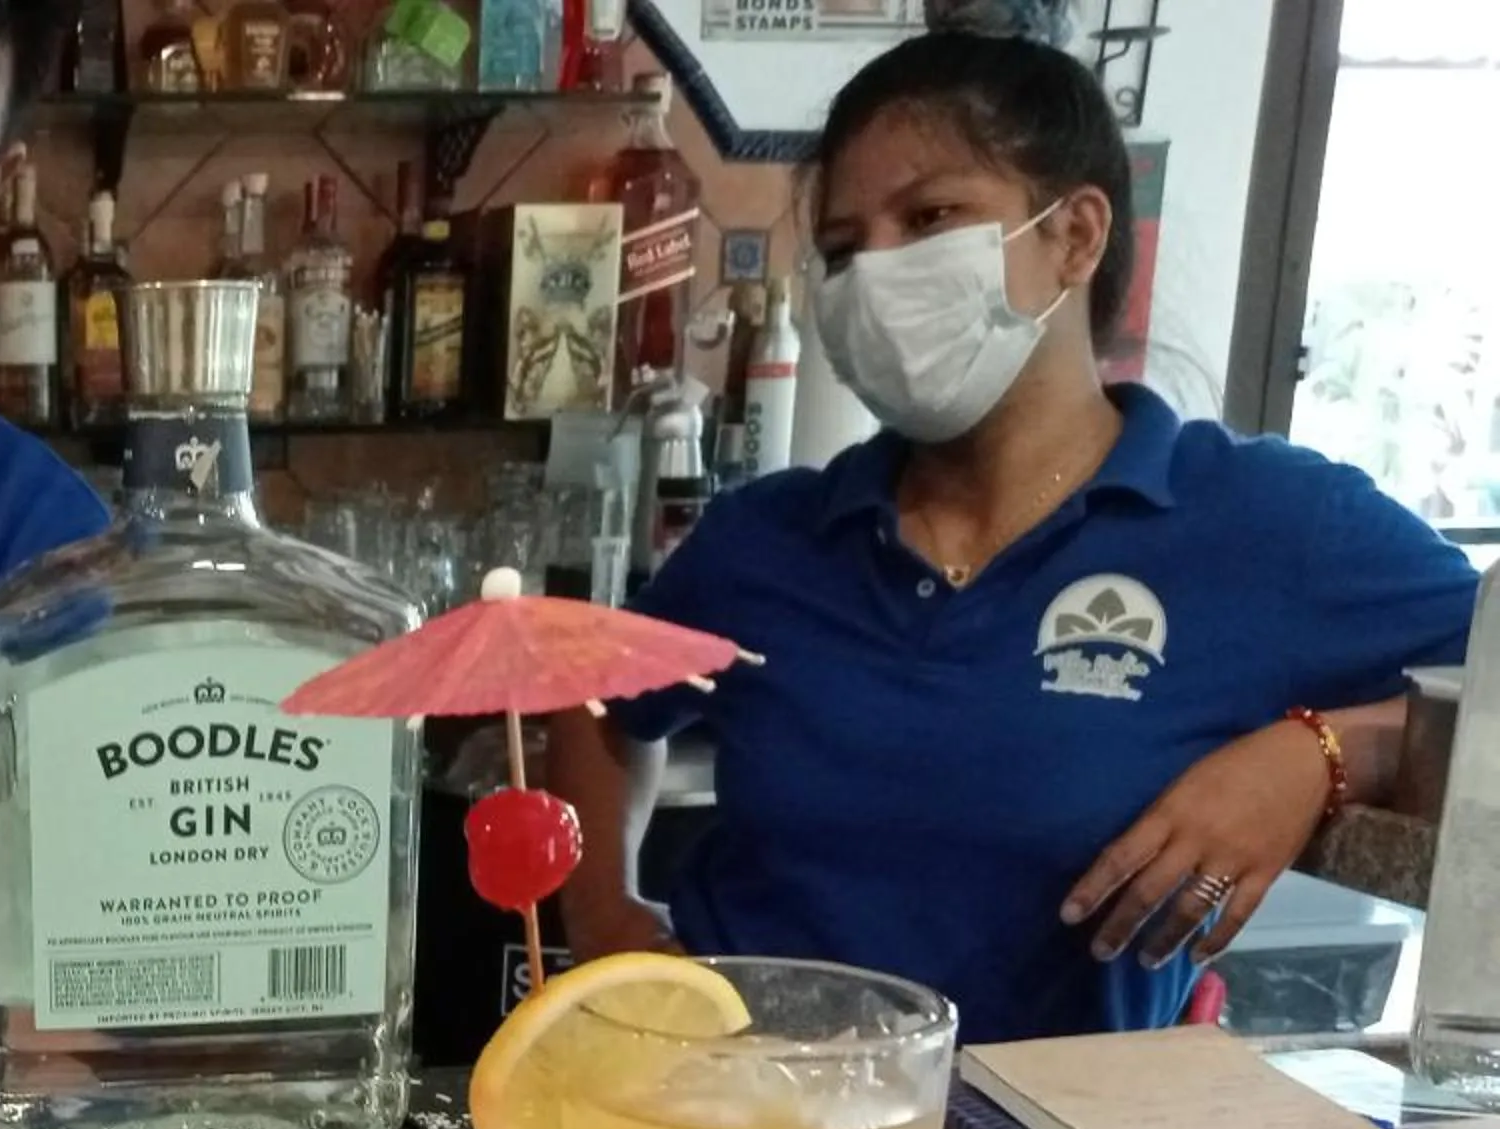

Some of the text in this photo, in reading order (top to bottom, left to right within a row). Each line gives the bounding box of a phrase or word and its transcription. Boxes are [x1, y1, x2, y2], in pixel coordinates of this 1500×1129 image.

[735, 16, 814, 31] STAMPS
[96, 723, 326, 780] BOODLES
[169, 776, 250, 796] BRITISH
[169, 803, 252, 838] GIN
[149, 846, 270, 866] LONDON DRY
[100, 888, 323, 914] WARRANTED TO PROOF
